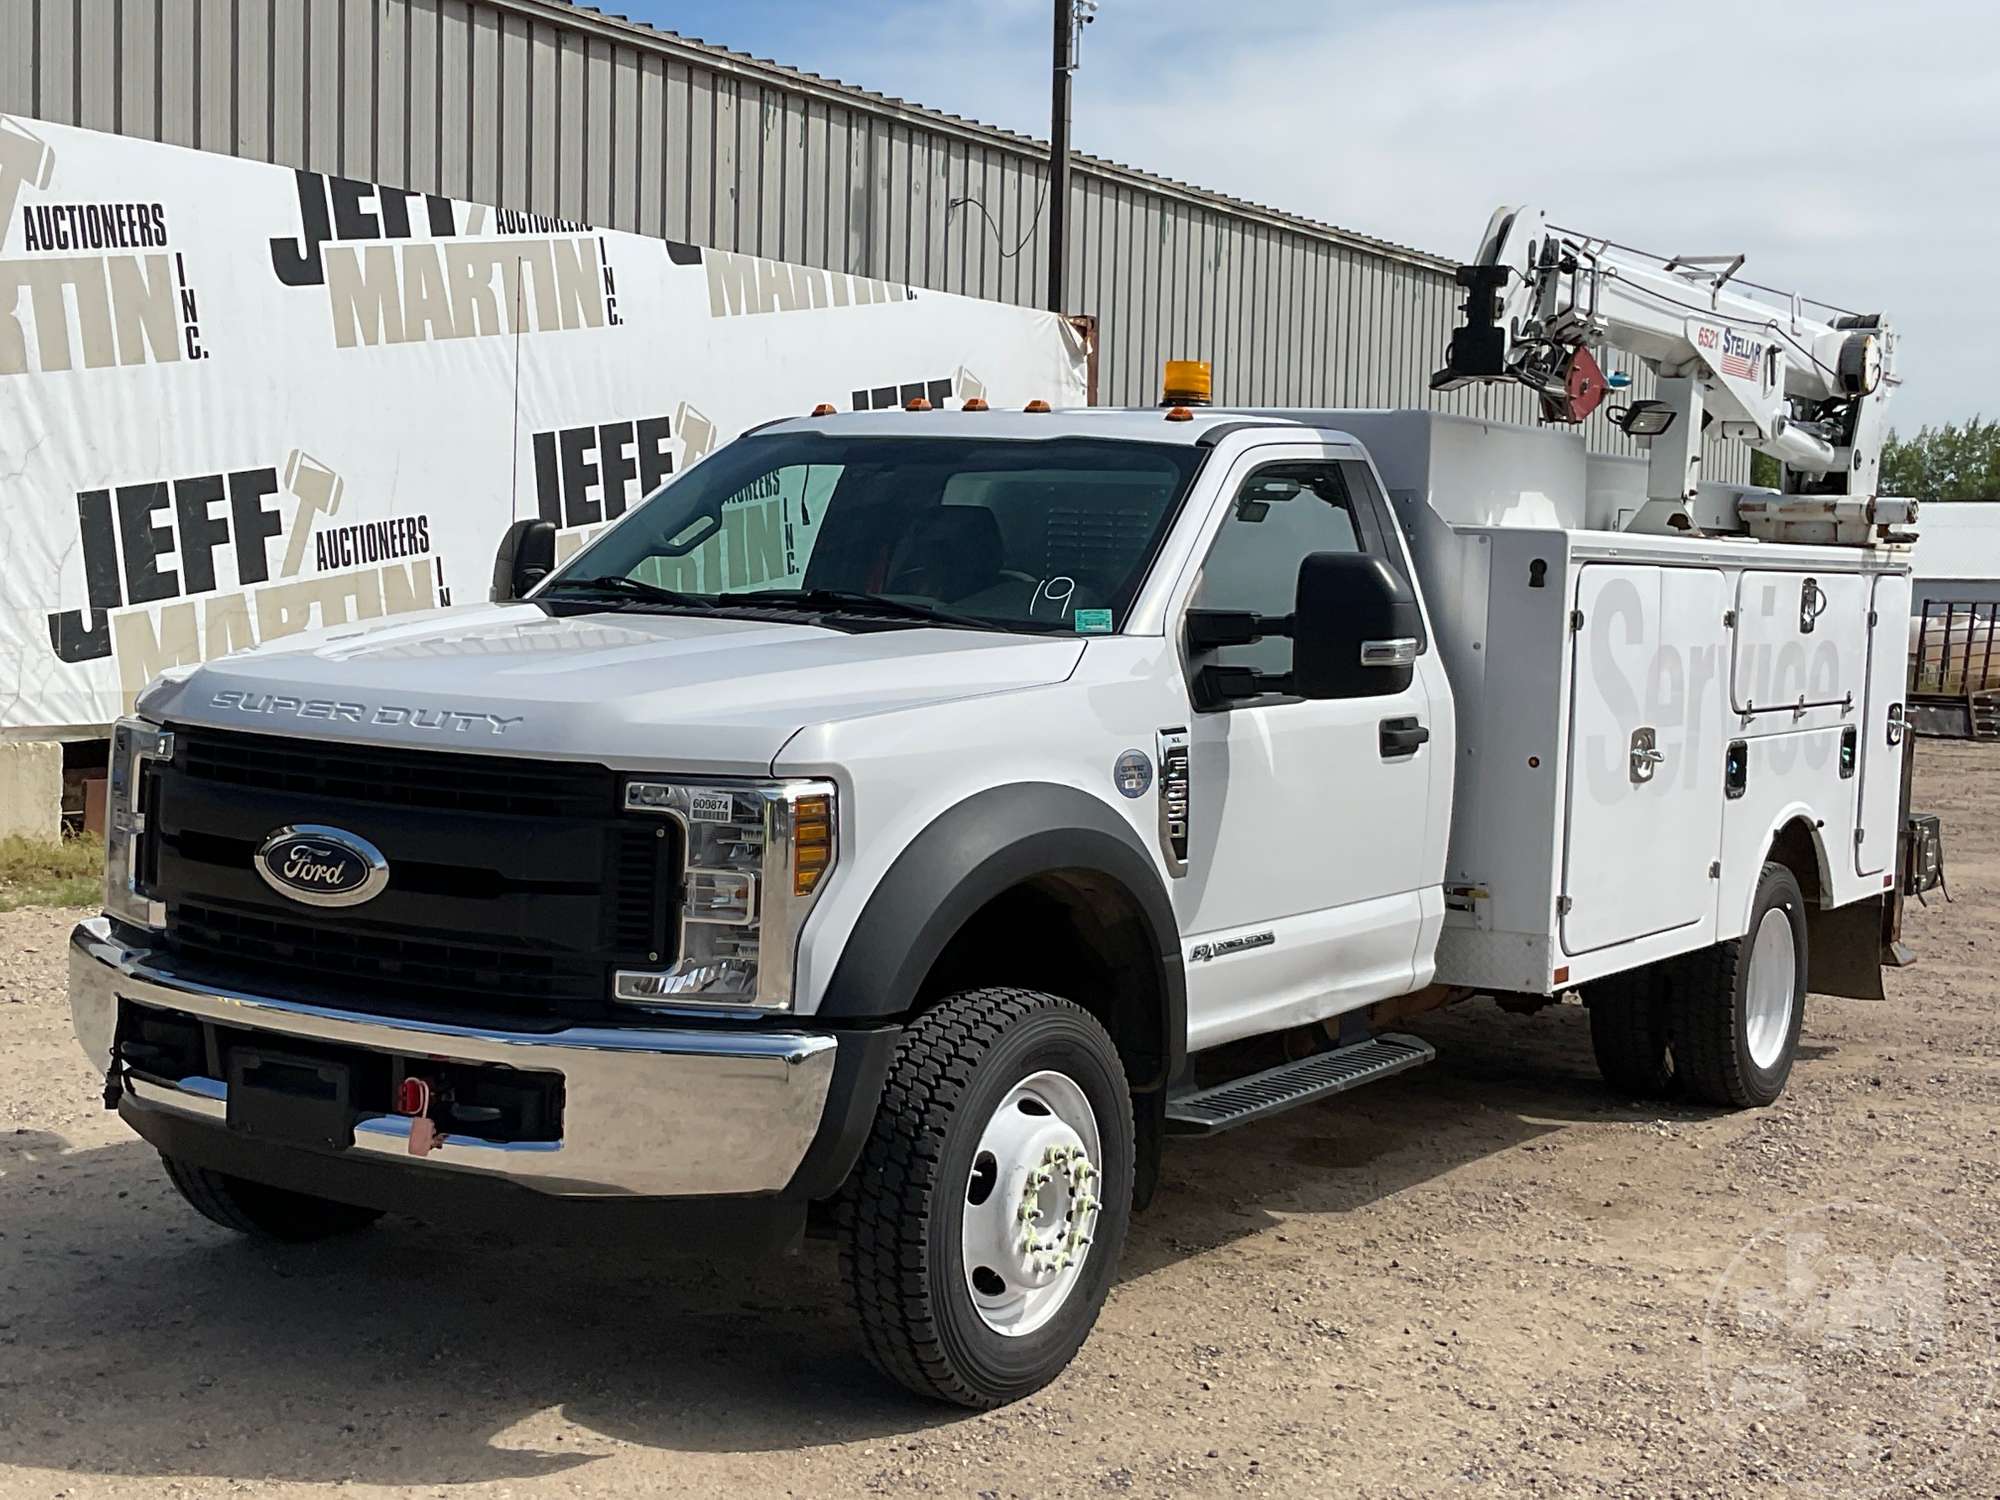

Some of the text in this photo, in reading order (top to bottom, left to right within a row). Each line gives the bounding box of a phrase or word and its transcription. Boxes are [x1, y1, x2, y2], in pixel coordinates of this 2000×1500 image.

[23, 203, 167, 251] AUCTIONEERS
[175, 252, 209, 360] INC.
[323, 239, 605, 348] MARTIN
[598, 236, 623, 327] INC.
[1698, 326, 1720, 349] 6521
[532, 416, 674, 530] JEFF
[47, 467, 283, 664] JEFF
[316, 514, 431, 572] AUCTIONEERS
[1029, 576, 1075, 619] 19
[209, 690, 524, 735] SUPER DUTY
[1585, 577, 1840, 806] Service
[283, 844, 346, 885] Ford
